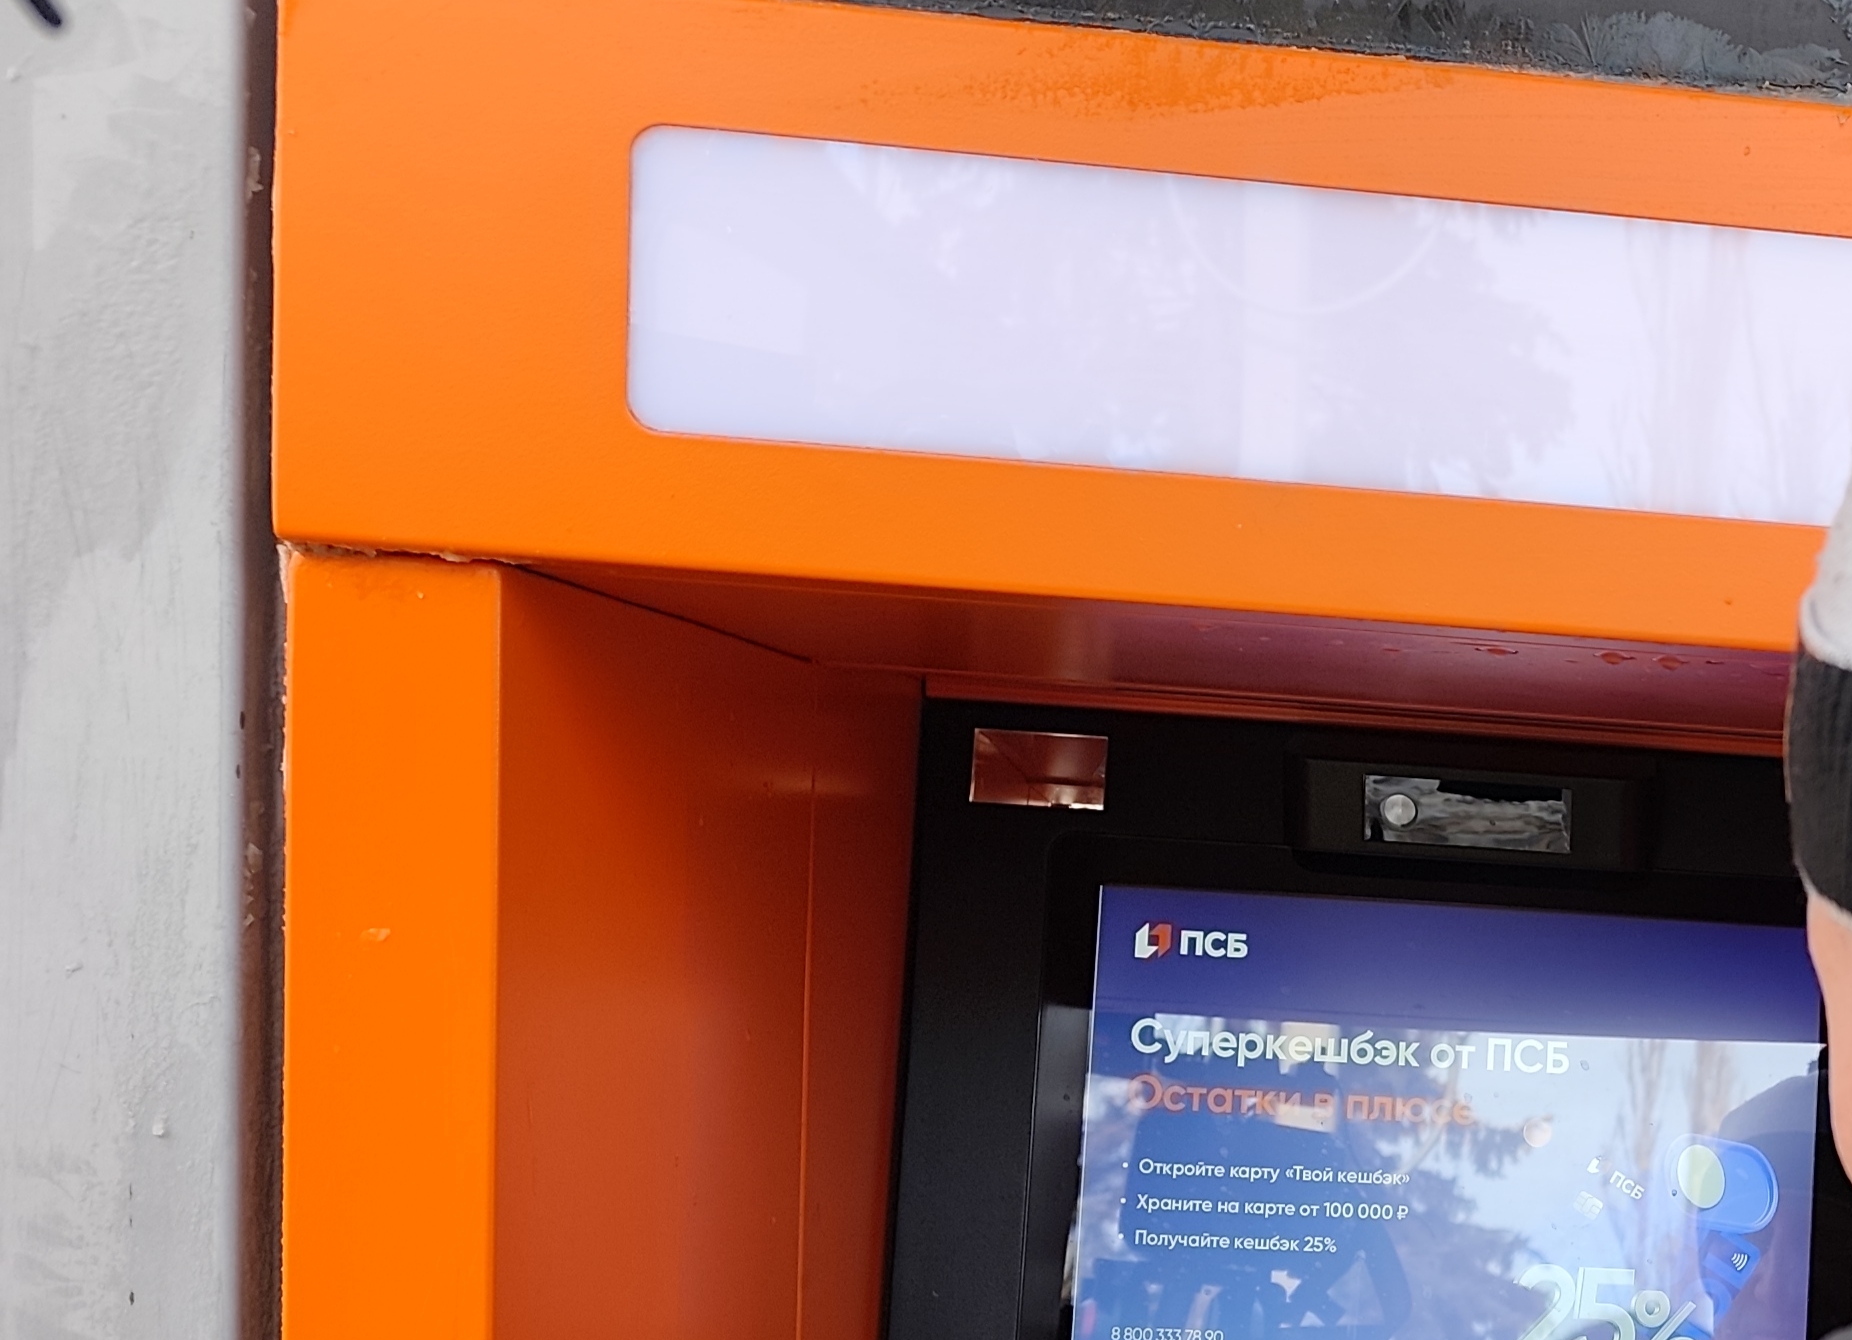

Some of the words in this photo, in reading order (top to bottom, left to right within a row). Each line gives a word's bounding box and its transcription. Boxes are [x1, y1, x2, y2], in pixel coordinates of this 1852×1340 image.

[1179, 929, 1249, 959] ПСБ
[1130, 1017, 1420, 1067] Суперкешбэк
[1430, 1043, 1476, 1070] от
[1486, 1037, 1570, 1074] ПСБ
[1128, 1073, 1302, 1116] Остатки
[1313, 1093, 1335, 1117] в
[1346, 1095, 1474, 1126] плюсе
[1138, 1158, 1225, 1178] Откройте
[1229, 1164, 1280, 1183] карту
[1285, 1165, 1334, 1182] «Твой
[1337, 1168, 1410, 1186] кешбэк»
[1609, 1170, 1645, 1200] ПСБ
[1136, 1193, 1213, 1213] Храните
[1217, 1200, 1240, 1213] на
[1244, 1201, 1296, 1218] карте
[1299, 1203, 1319, 1217] от
[1323, 1202, 1354, 1218] 100
[1357, 1203, 1393, 1220] 000
[1134, 1229, 1230, 1250] Получайте
[1234, 1235, 1300, 1252] кешбэк
[1303, 1236, 1337, 1253] 25%
[1111, 1327, 1120, 1340] 8
